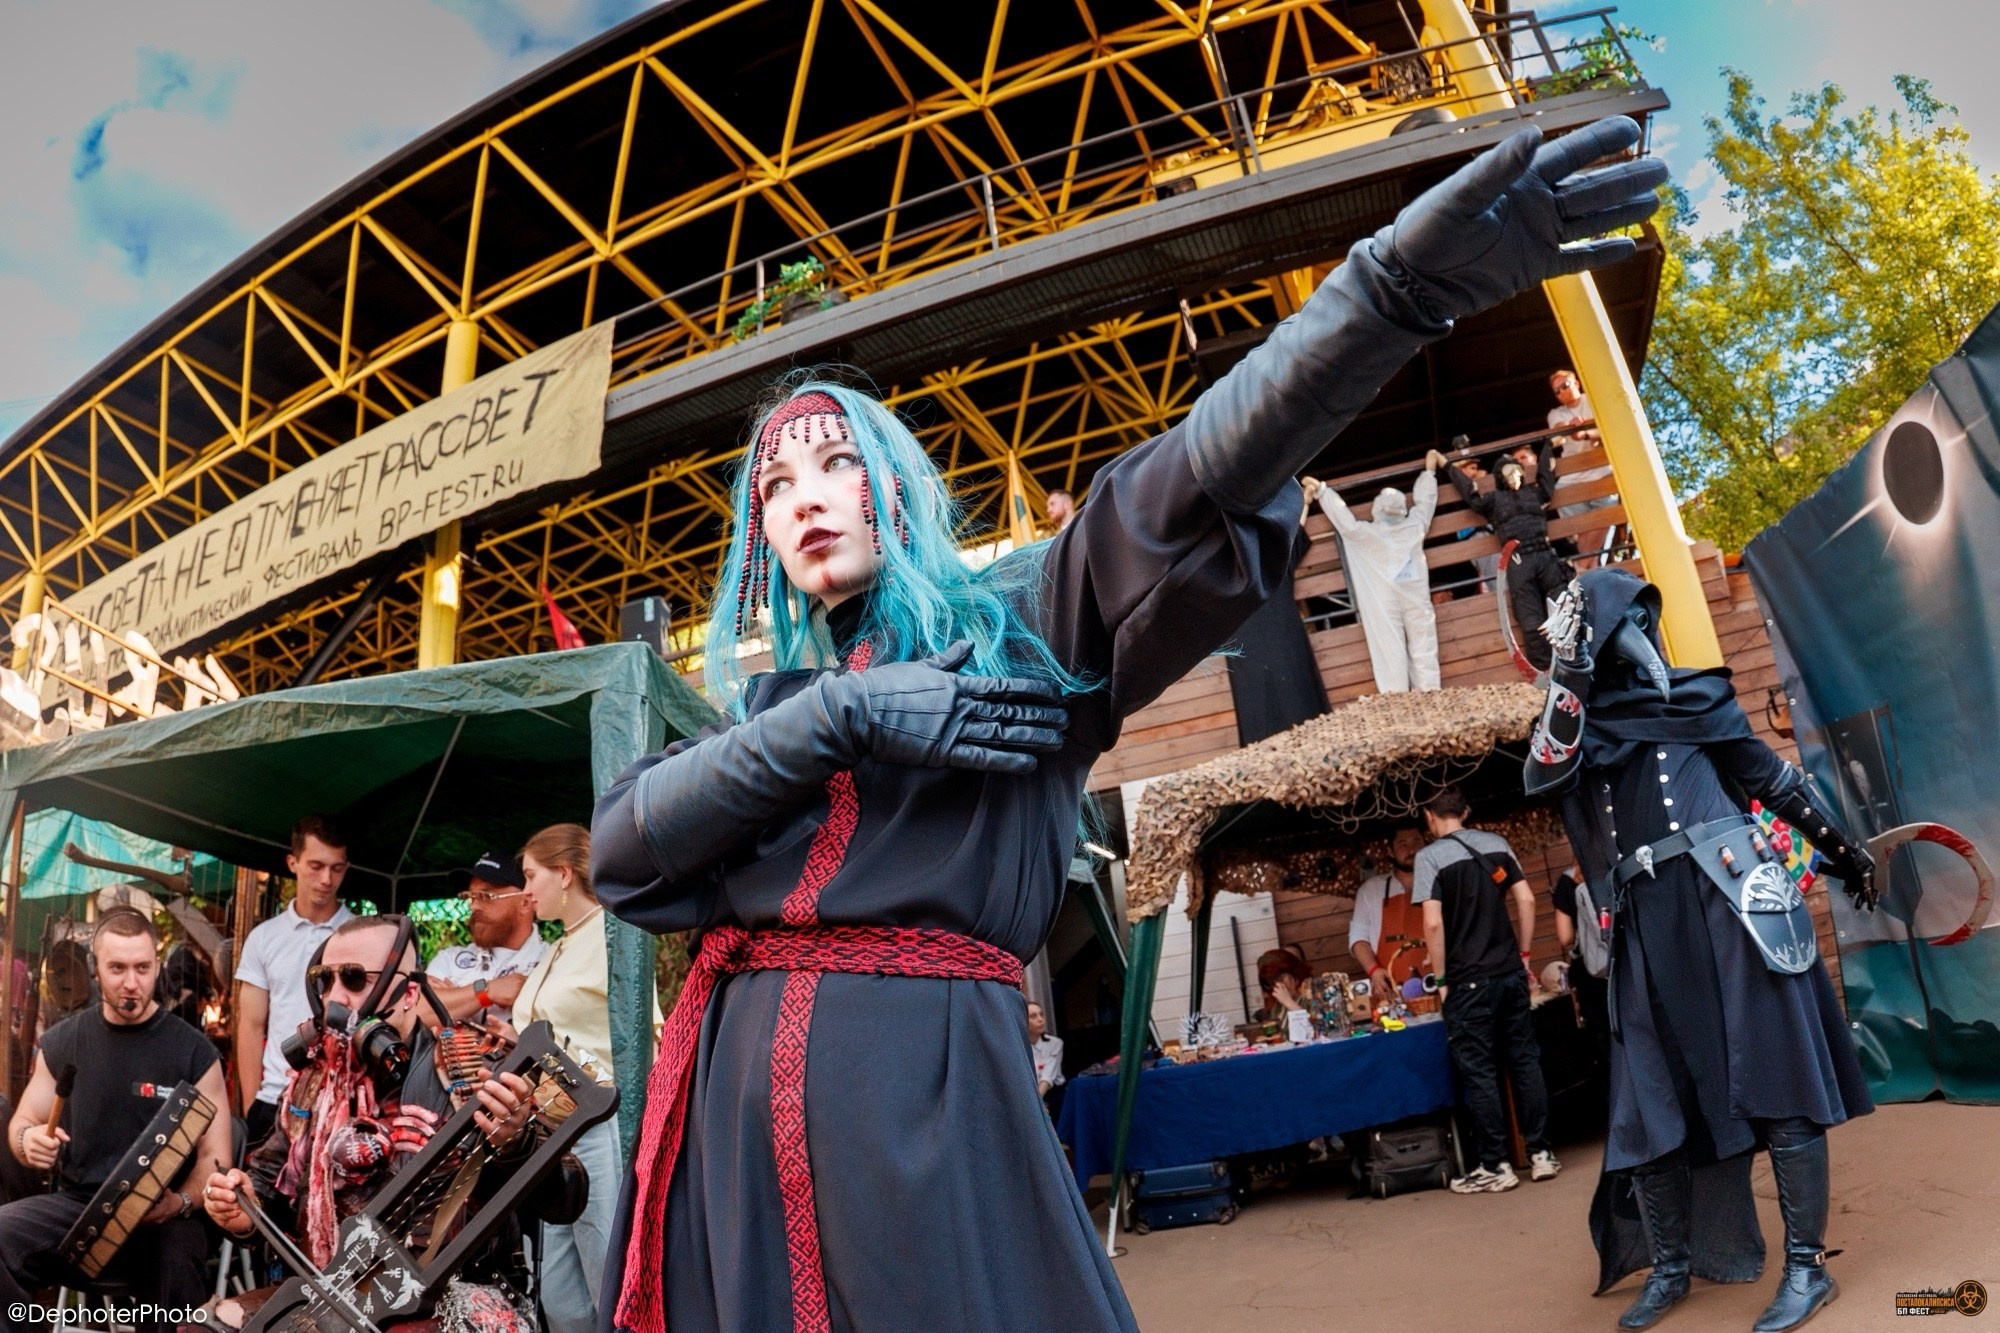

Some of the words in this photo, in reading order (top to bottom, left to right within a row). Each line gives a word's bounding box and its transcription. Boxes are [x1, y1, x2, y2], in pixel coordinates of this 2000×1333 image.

[172, 527, 222, 607] НЕ
[376, 369, 564, 500] РАССВЕТ
[263, 527, 363, 593] ФЕСТИВАЛЬ
[377, 458, 524, 545] BP-FEST.RU
